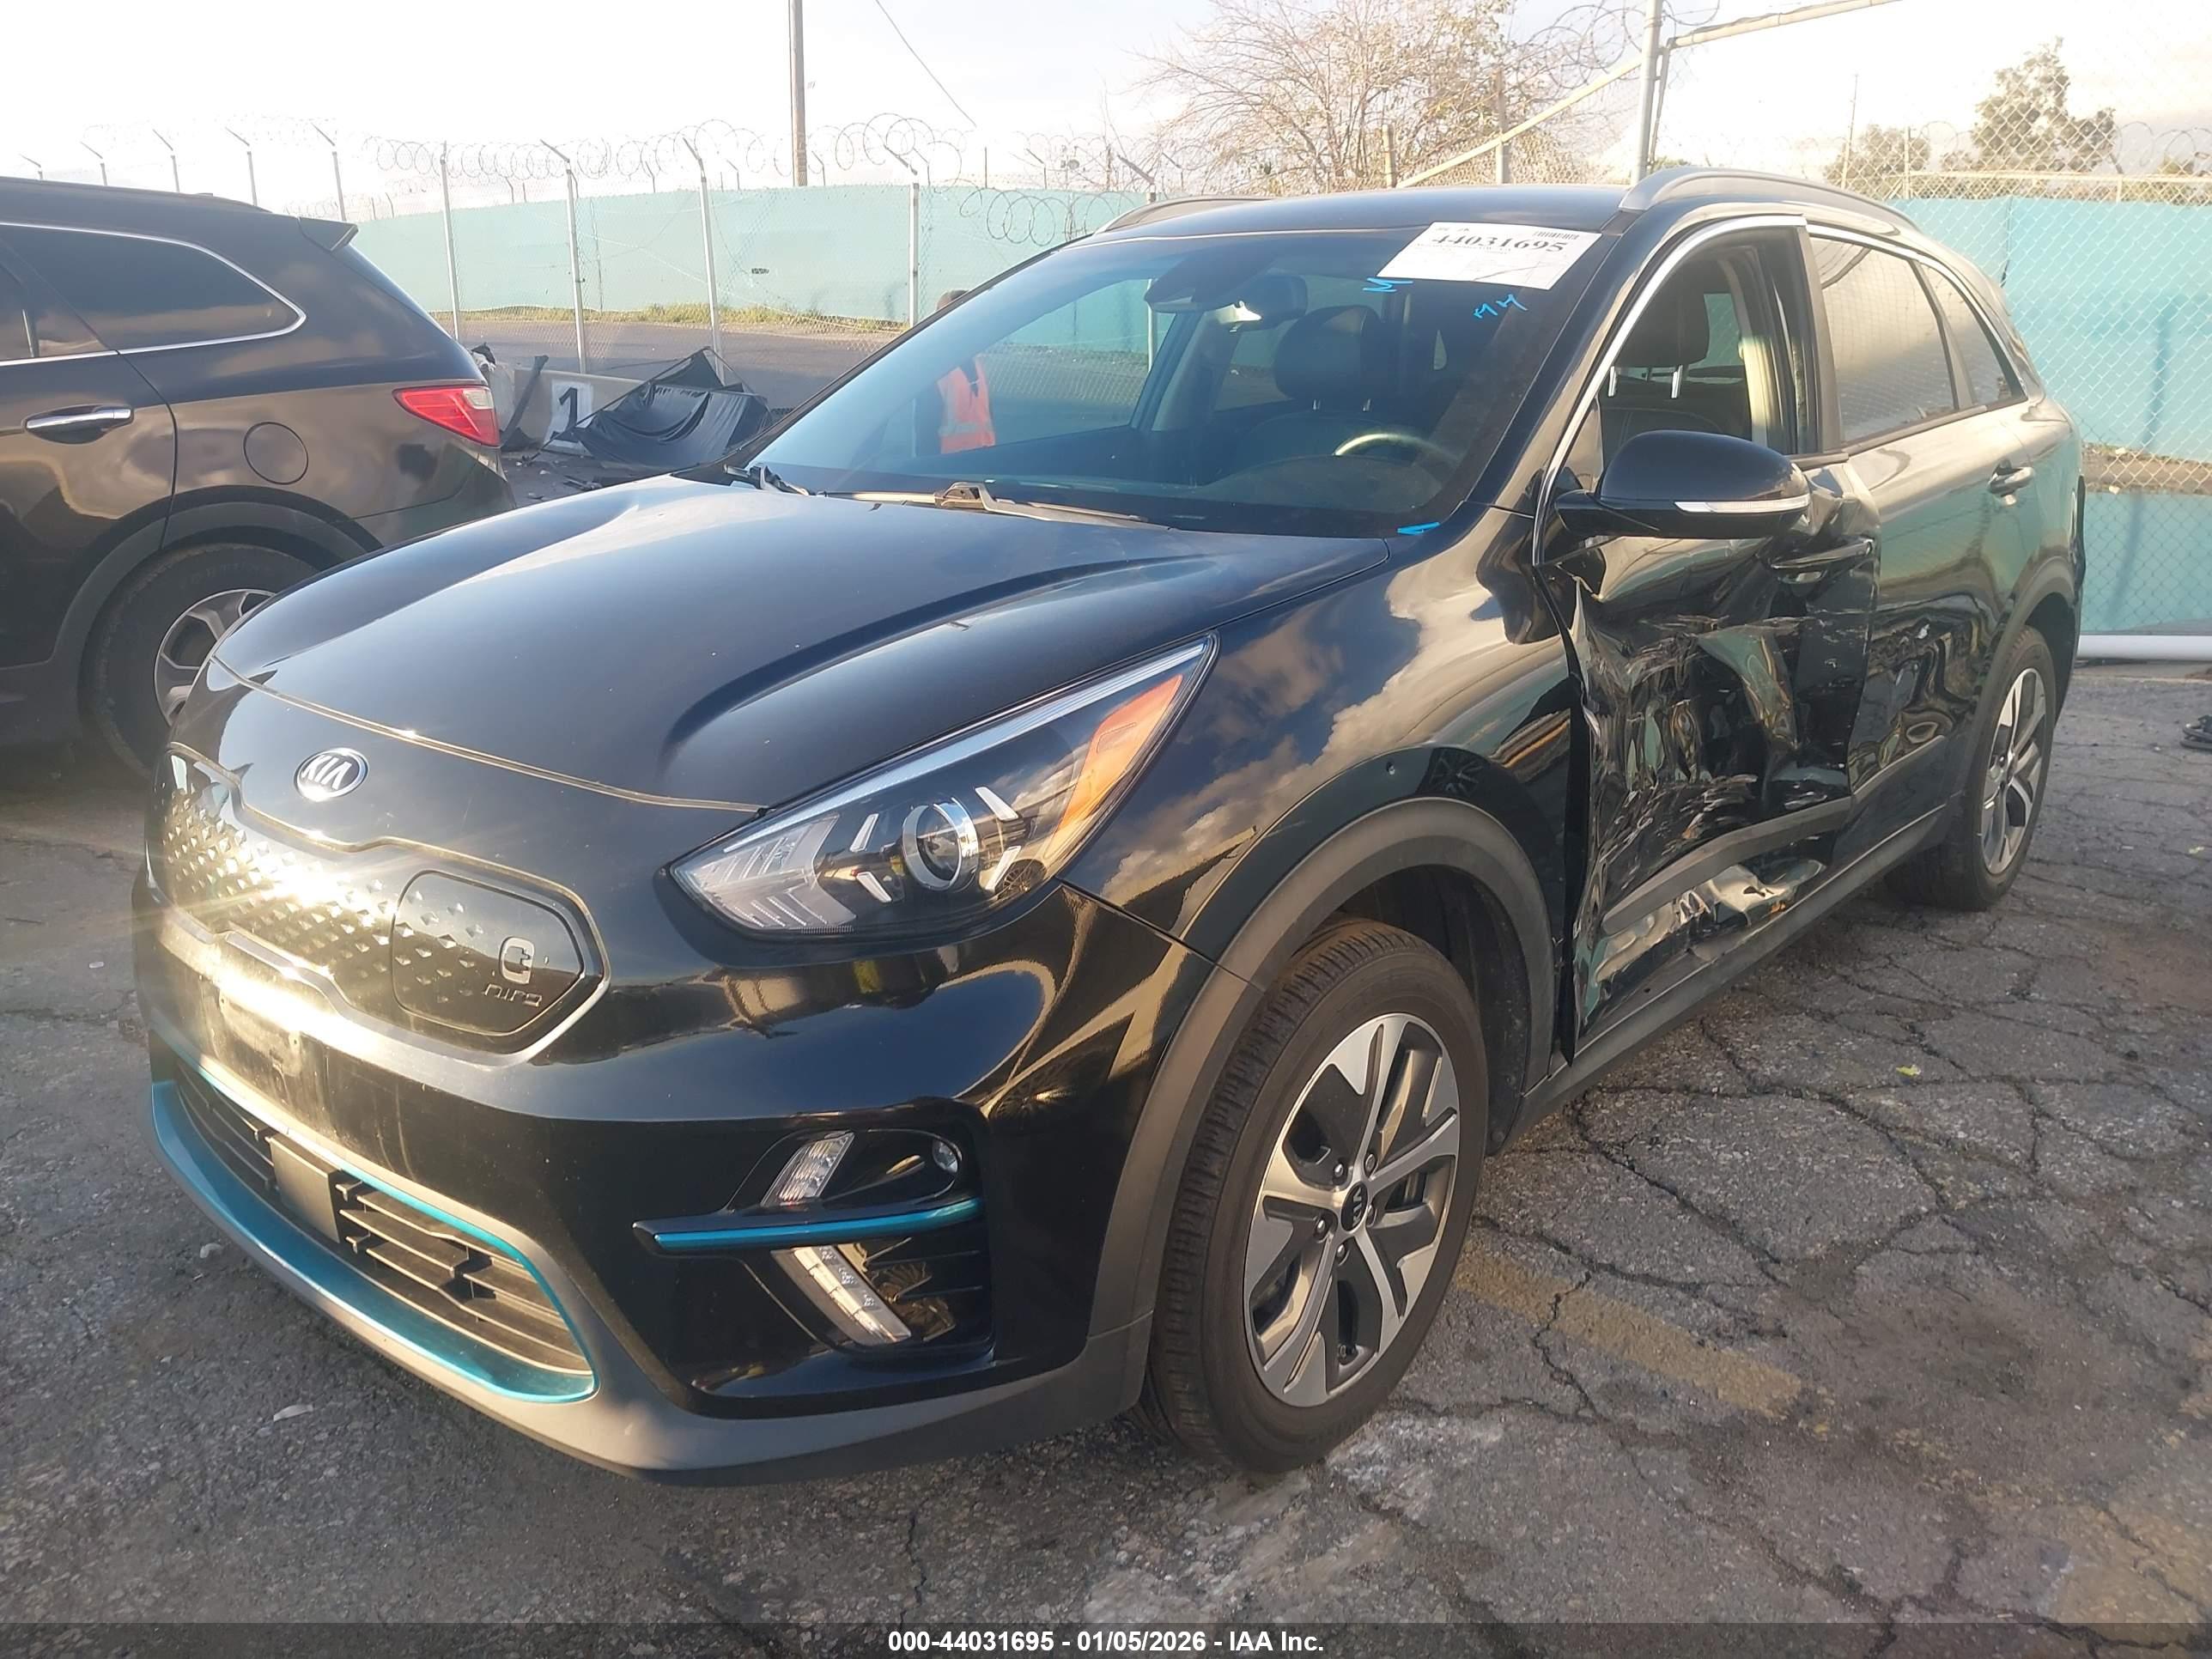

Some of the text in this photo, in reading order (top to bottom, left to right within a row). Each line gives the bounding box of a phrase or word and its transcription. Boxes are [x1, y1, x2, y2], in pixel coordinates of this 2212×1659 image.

[1431, 234, 1568, 252] 44031695
[550, 386, 580, 443] 1
[301, 755, 352, 790] KIA
[483, 982, 543, 1007] niro
[1352, 1186, 1363, 1228] KIA
